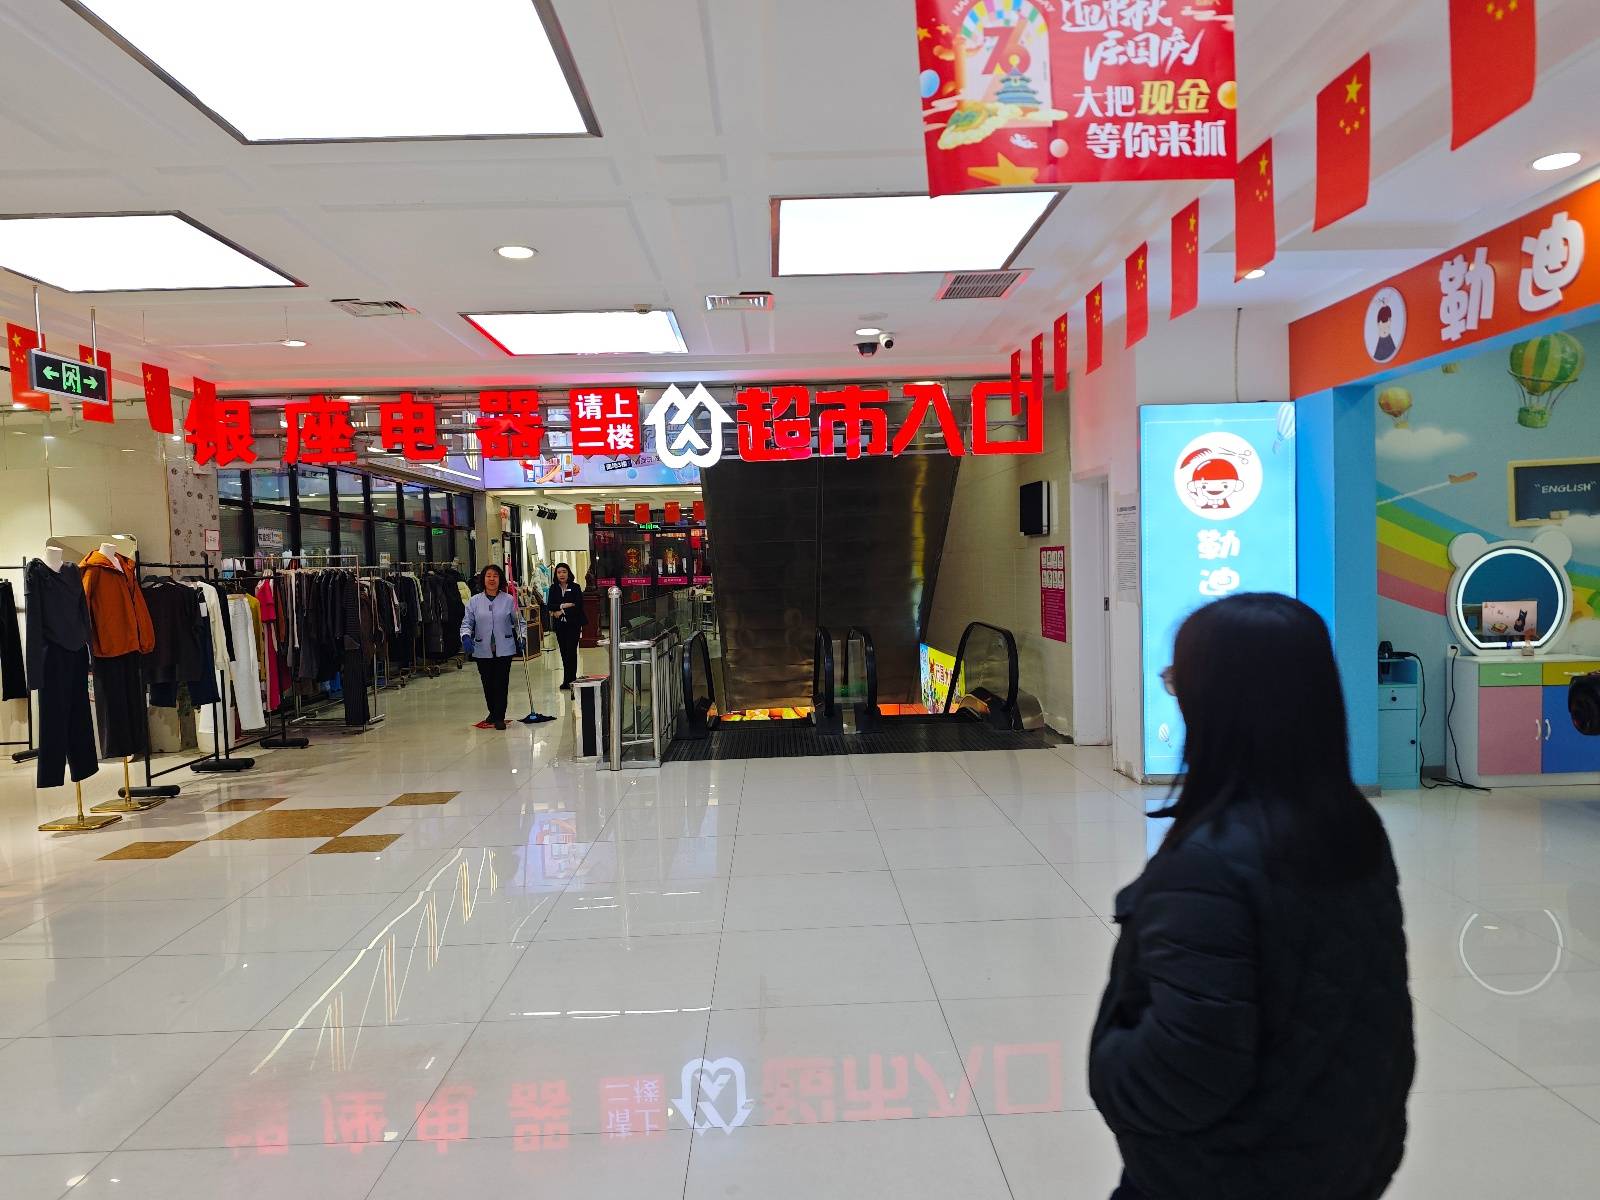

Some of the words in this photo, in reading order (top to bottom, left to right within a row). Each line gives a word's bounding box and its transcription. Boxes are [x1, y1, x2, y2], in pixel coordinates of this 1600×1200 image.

[1073, 78, 1212, 118] 大把现金
[1085, 119, 1227, 159] 等你来抓
[575, 392, 634, 421] 请上
[735, 381, 1044, 463] 超市入口
[184, 387, 544, 467] 银座电器
[576, 424, 635, 451] 二楼
